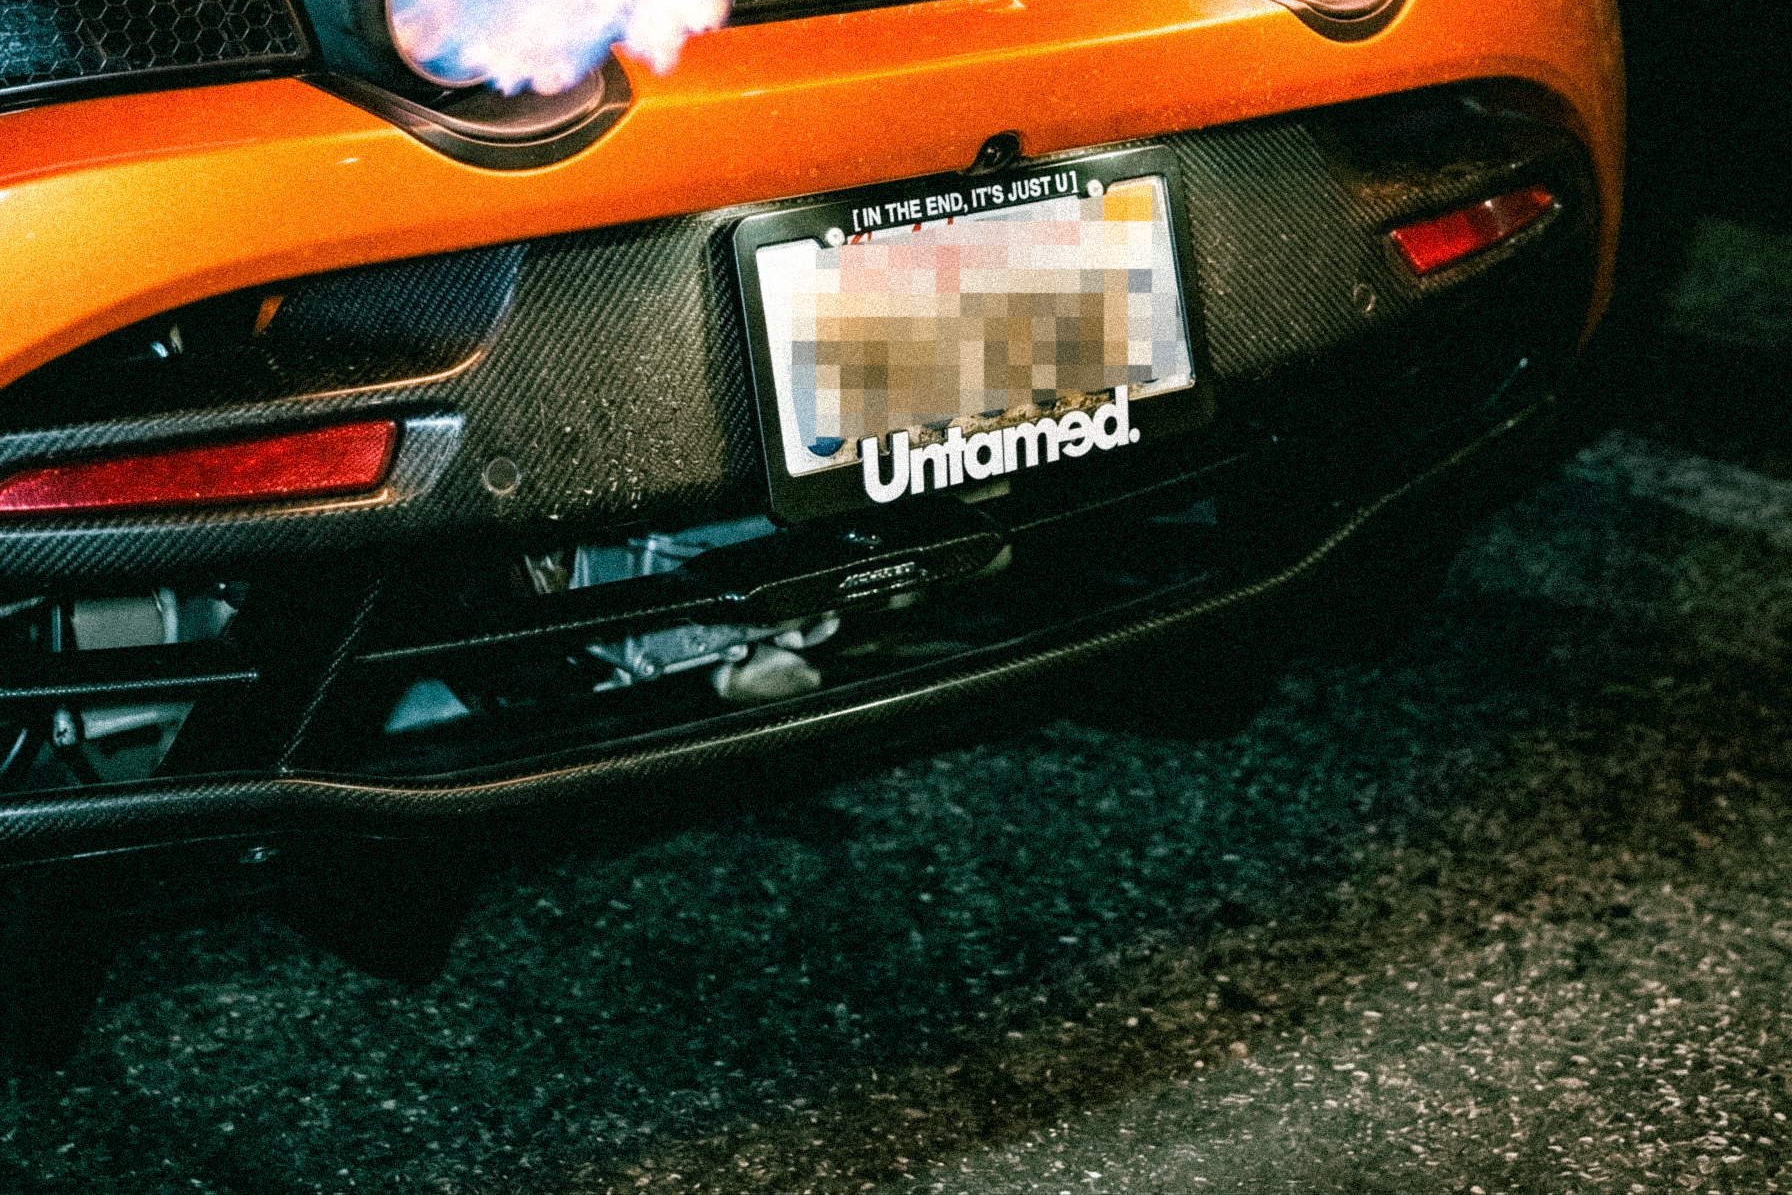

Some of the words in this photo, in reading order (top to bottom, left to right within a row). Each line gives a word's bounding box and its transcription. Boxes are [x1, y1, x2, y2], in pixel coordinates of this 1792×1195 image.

[885, 199, 922, 223] THE
[925, 192, 968, 216] END,
[971, 184, 1005, 208] IT'S
[1007, 176, 1051, 202] JUST
